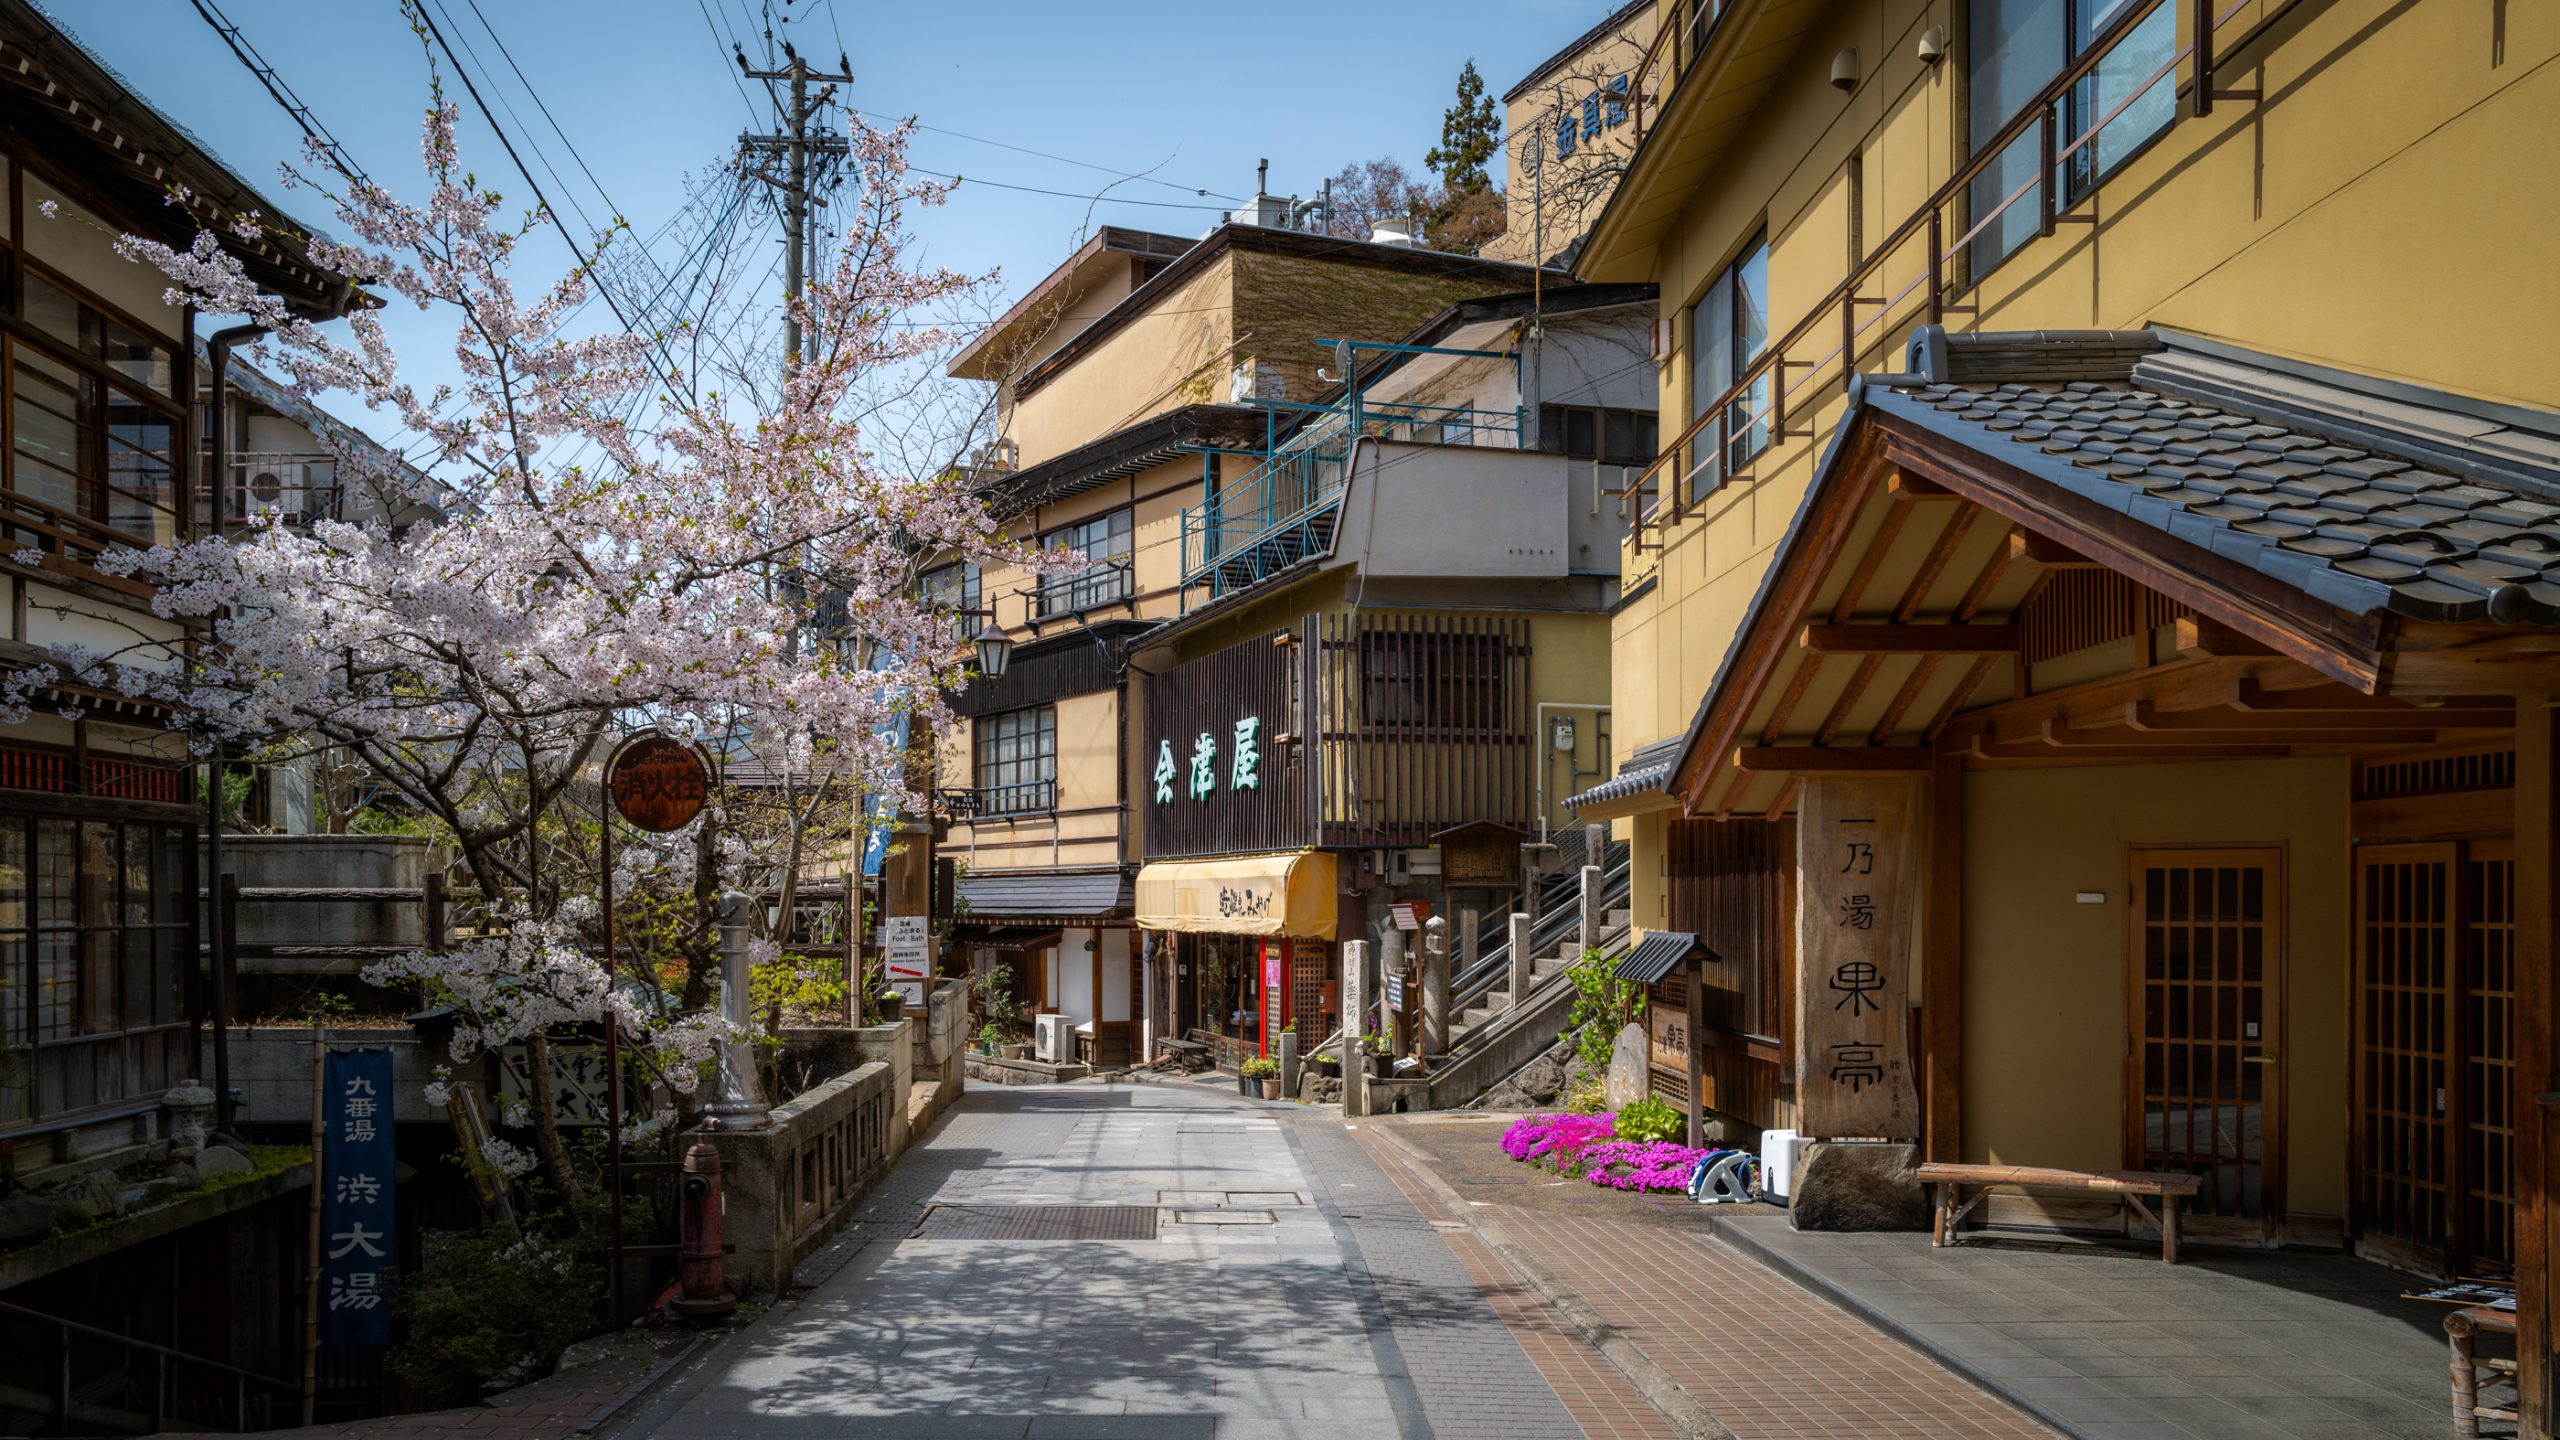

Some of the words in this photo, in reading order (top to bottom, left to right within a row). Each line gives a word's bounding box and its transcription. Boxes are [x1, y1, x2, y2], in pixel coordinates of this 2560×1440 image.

[616, 767, 701, 801] 消火栓
[1153, 716, 1260, 804] 会津屋
[910, 934, 925, 942] Bath
[344, 1075, 378, 1144] 九番湯
[328, 1173, 387, 1312] 渋大湯
